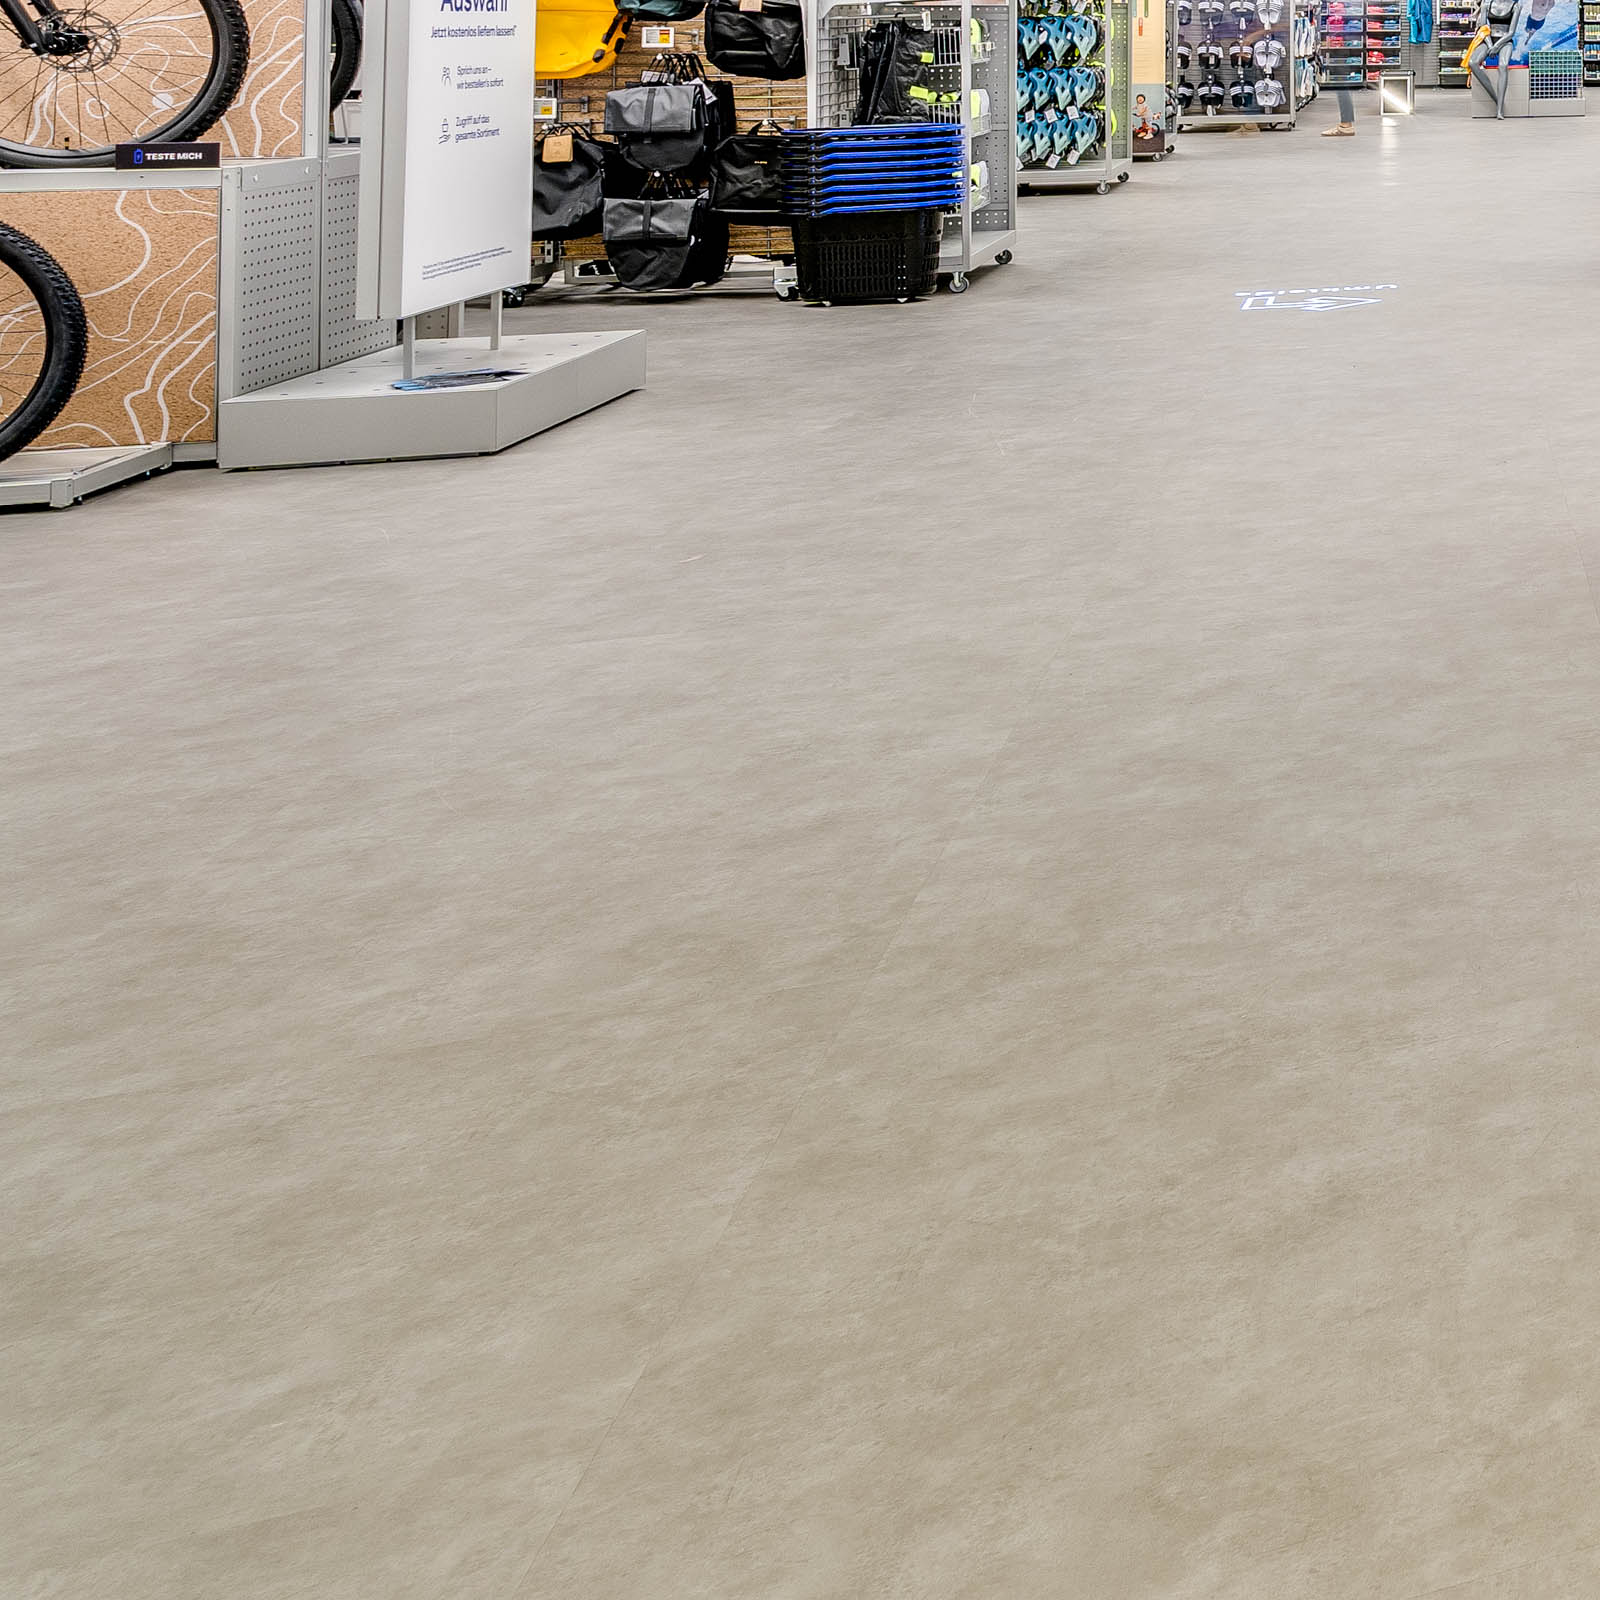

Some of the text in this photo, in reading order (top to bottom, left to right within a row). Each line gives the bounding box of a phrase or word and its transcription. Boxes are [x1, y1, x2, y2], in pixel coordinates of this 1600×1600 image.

[431, 26, 447, 38] Jetzt
[448, 25, 477, 37] kostenlos
[145, 152, 203, 160] TESTE MICH
